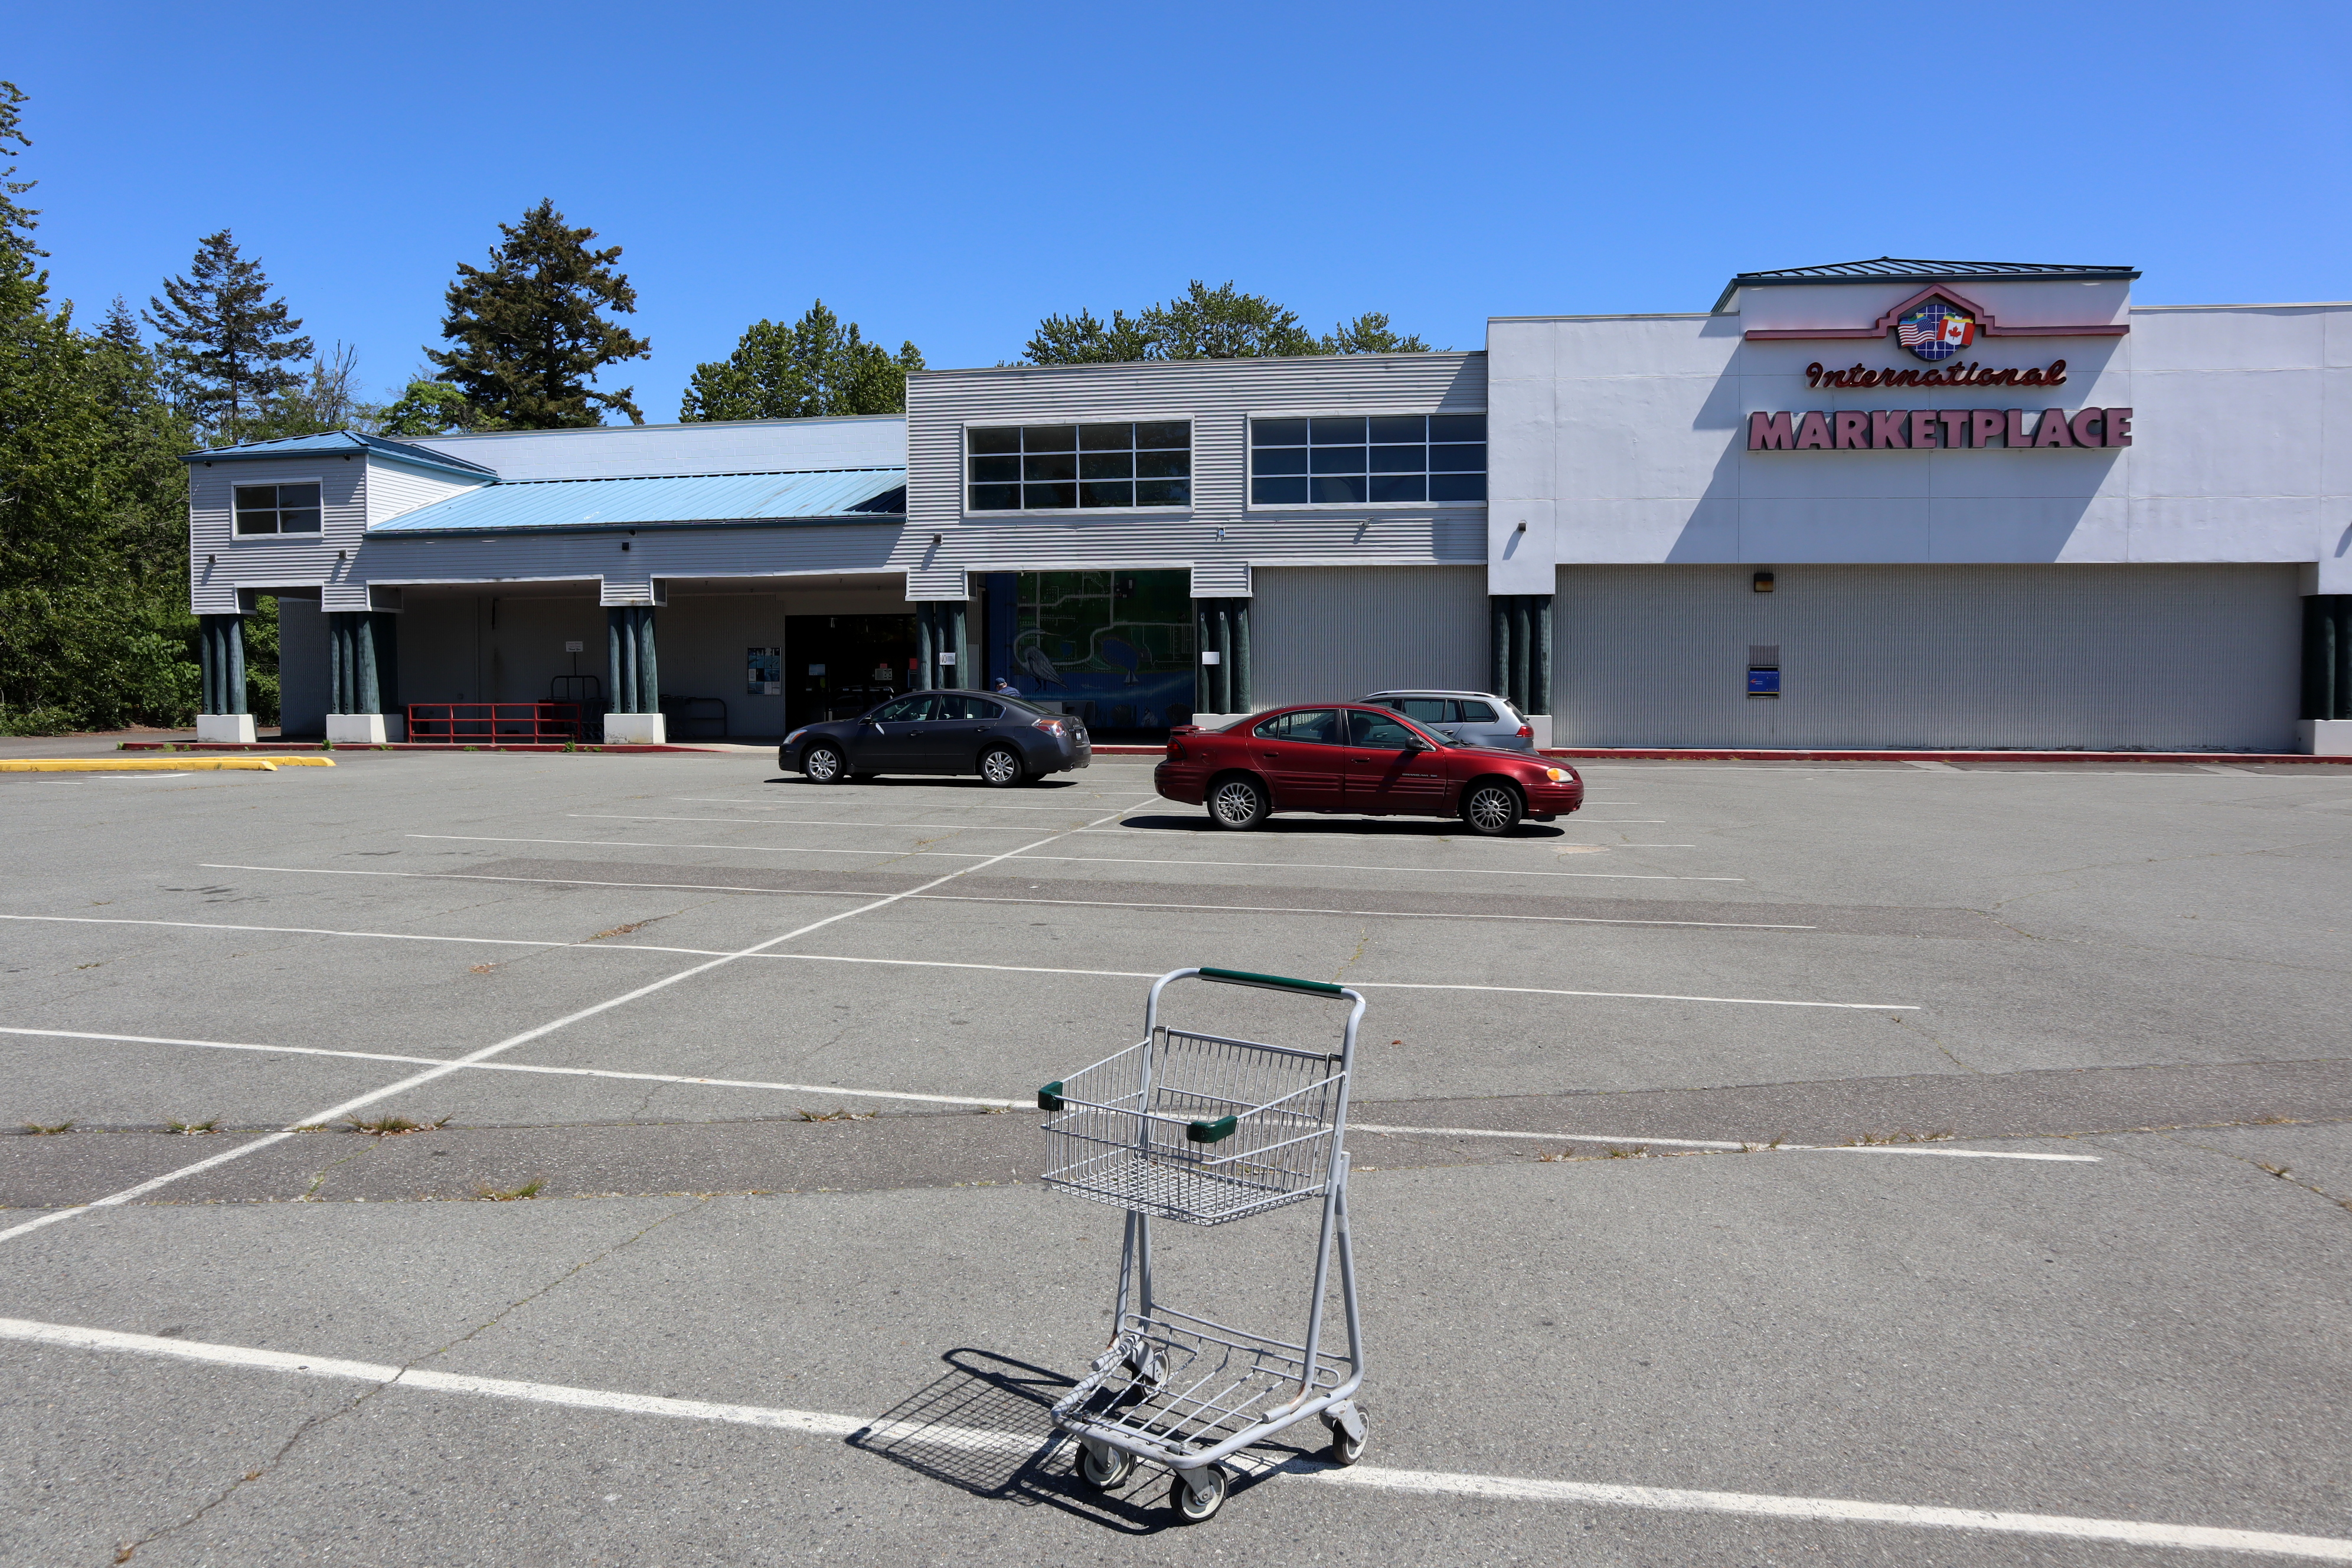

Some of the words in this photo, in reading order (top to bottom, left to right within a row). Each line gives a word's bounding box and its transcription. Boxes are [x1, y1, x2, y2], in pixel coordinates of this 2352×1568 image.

[1805, 359, 2067, 388] International
[1749, 407, 2133, 449] MARKETPLACE
[940, 655, 947, 663] NO
